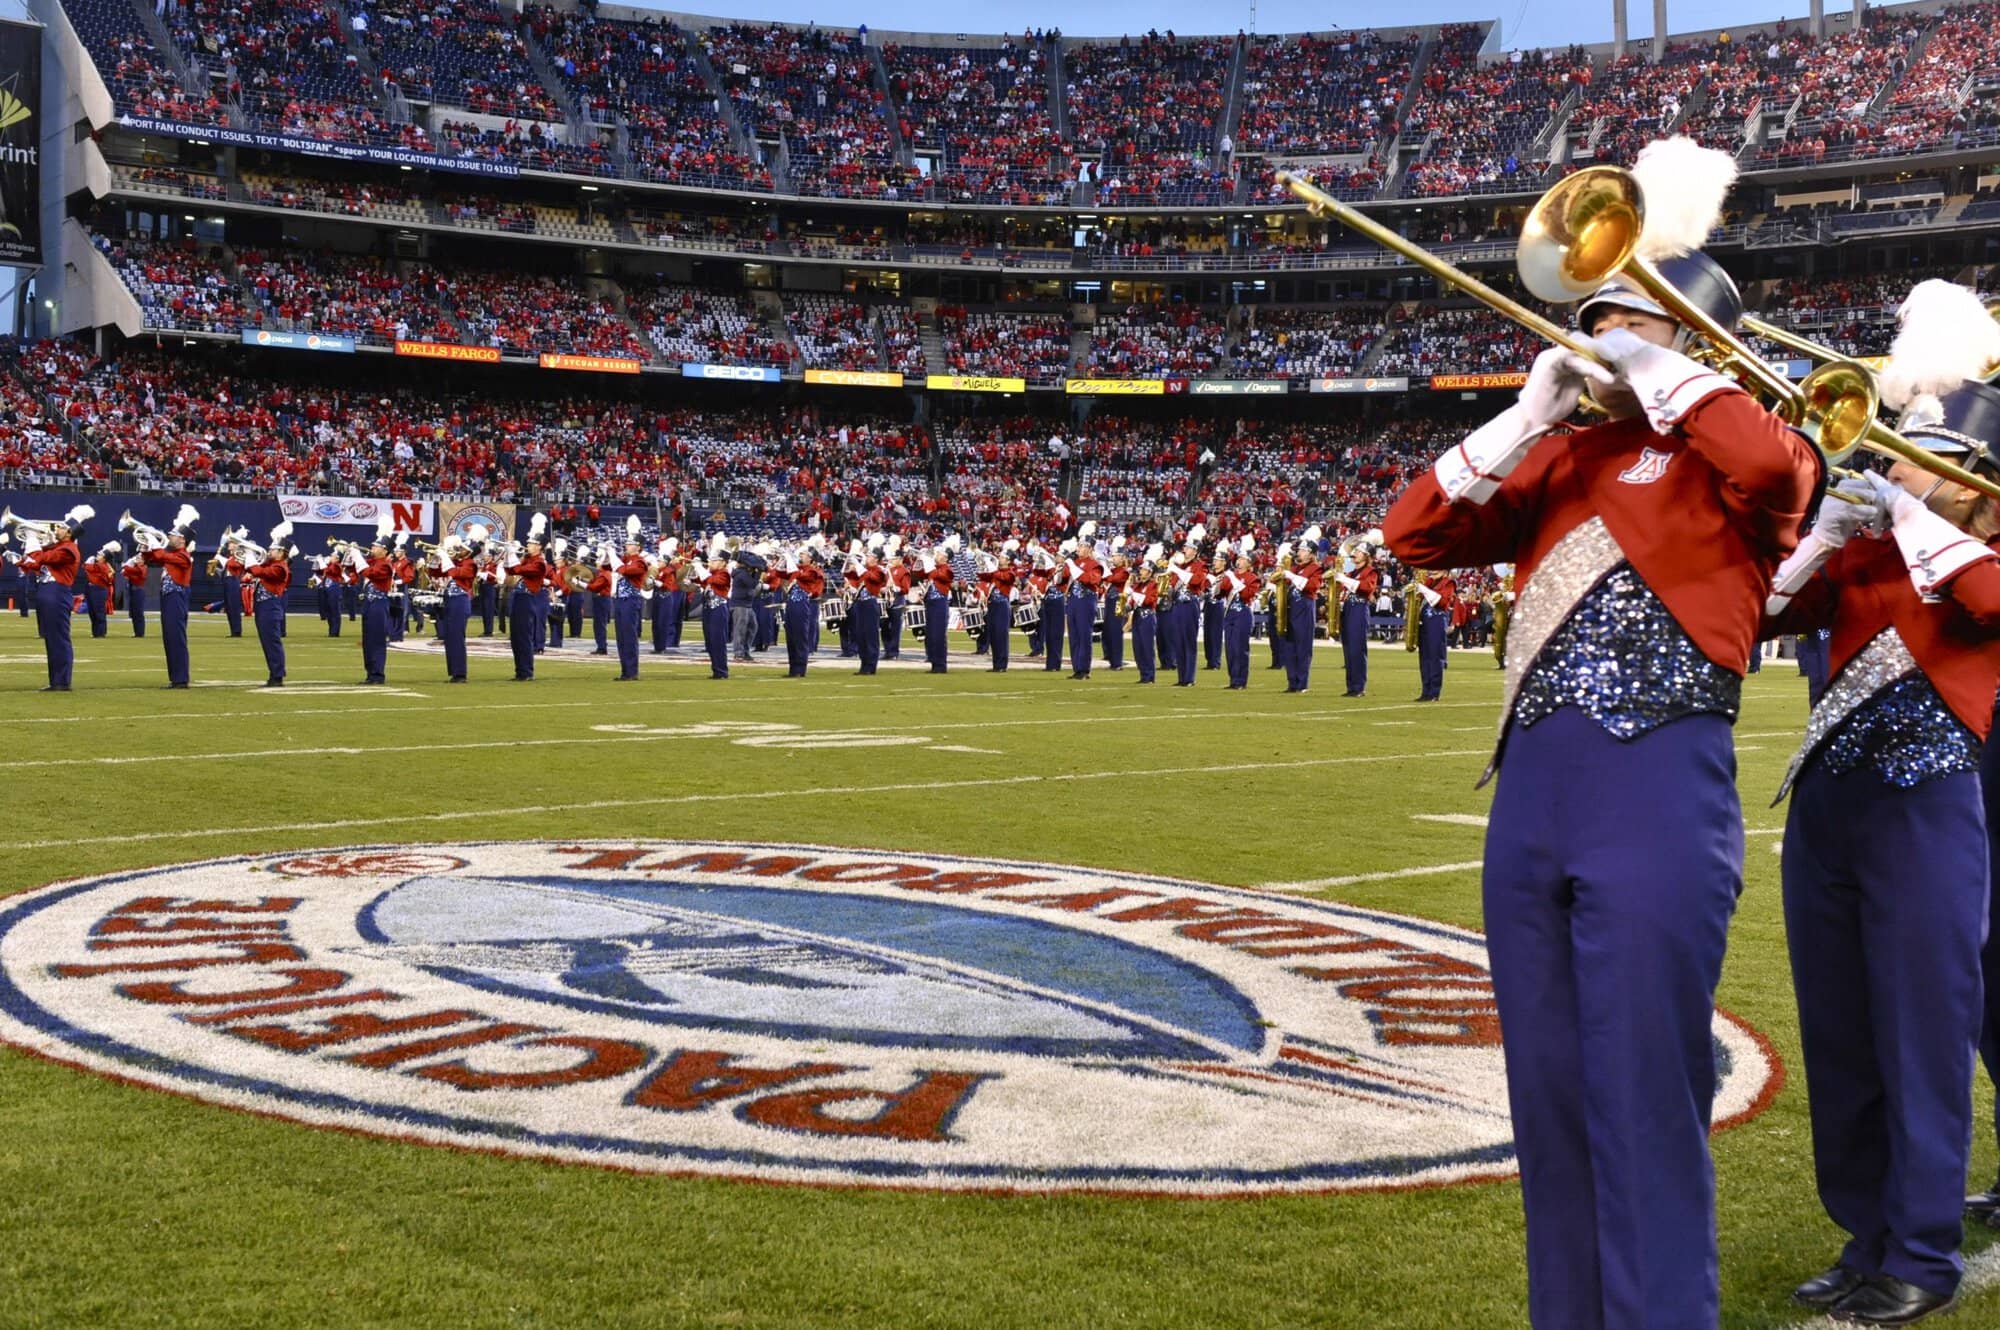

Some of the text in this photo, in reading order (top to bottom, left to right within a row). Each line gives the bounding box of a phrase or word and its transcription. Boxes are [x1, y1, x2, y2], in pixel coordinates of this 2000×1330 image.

[155, 123, 174, 133] FAN
[175, 125, 218, 139] CONDUCT
[221, 131, 254, 144] ISSUES,
[256, 135, 278, 146] TEXT
[279, 138, 333, 152] "BOLTSFAN"
[369, 149, 393, 161] YOUR
[394, 152, 436, 166] LOCATION
[438, 158, 456, 168] AND
[457, 160, 480, 171] ISSUE
[482, 163, 493, 172] TO
[400, 343, 498, 361] WELLS FARGO
[563, 358, 638, 370] SYCUAN RESORT
[703, 364, 765, 380] GEICO
[819, 372, 889, 385] CYMER
[1434, 374, 1528, 388] WELLS FARGO
[1617, 446, 1673, 484] A
[392, 503, 422, 532] N
[551, 845, 1060, 894] BOWL
[113, 966, 1004, 1143] PACIFIC
